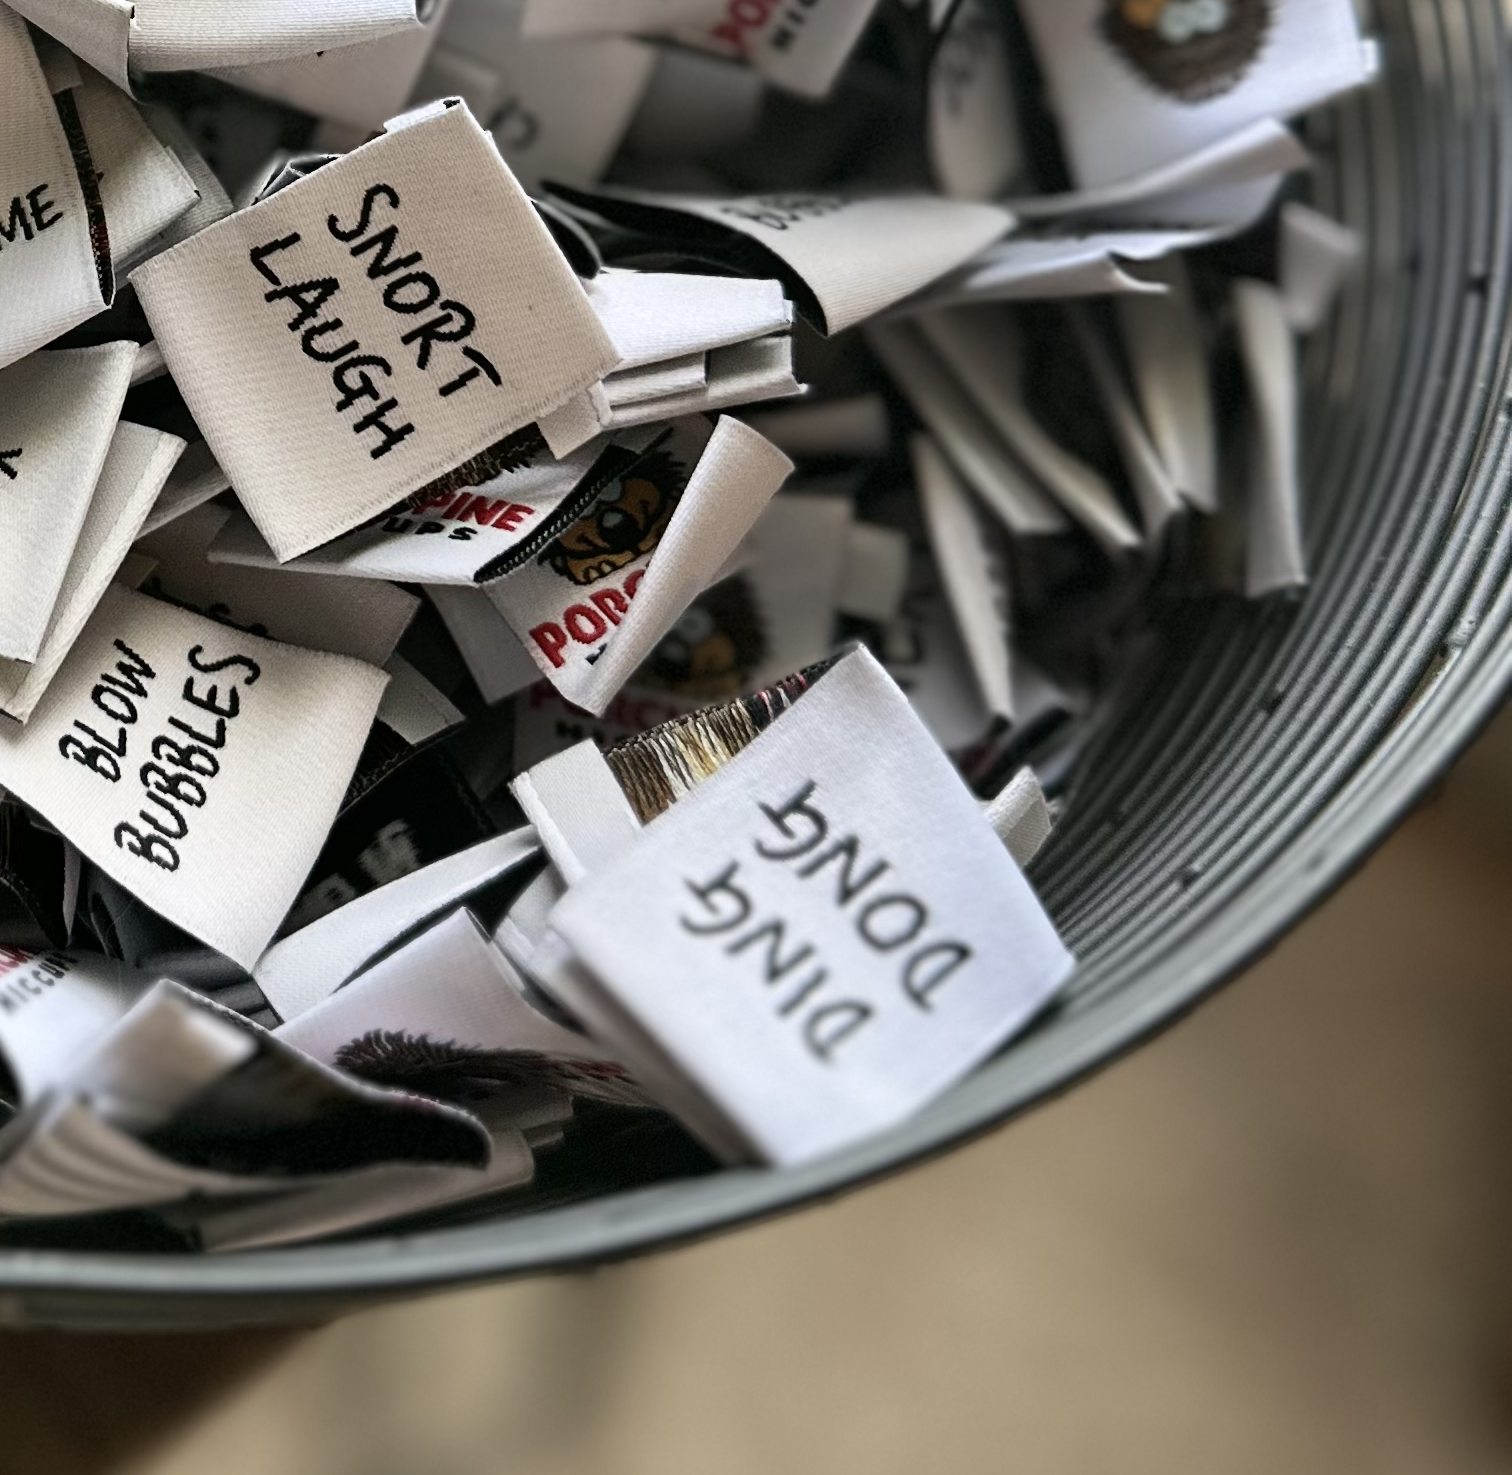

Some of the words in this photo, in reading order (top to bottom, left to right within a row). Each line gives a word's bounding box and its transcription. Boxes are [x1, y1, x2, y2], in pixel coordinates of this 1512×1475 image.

[249, 231, 416, 460] LAUGH
[326, 183, 503, 398] SNORT
[59, 637, 157, 784] BLOW
[114, 644, 262, 874] BUBBLES
[679, 861, 875, 1064] DING
[754, 779, 975, 1013] DONG
